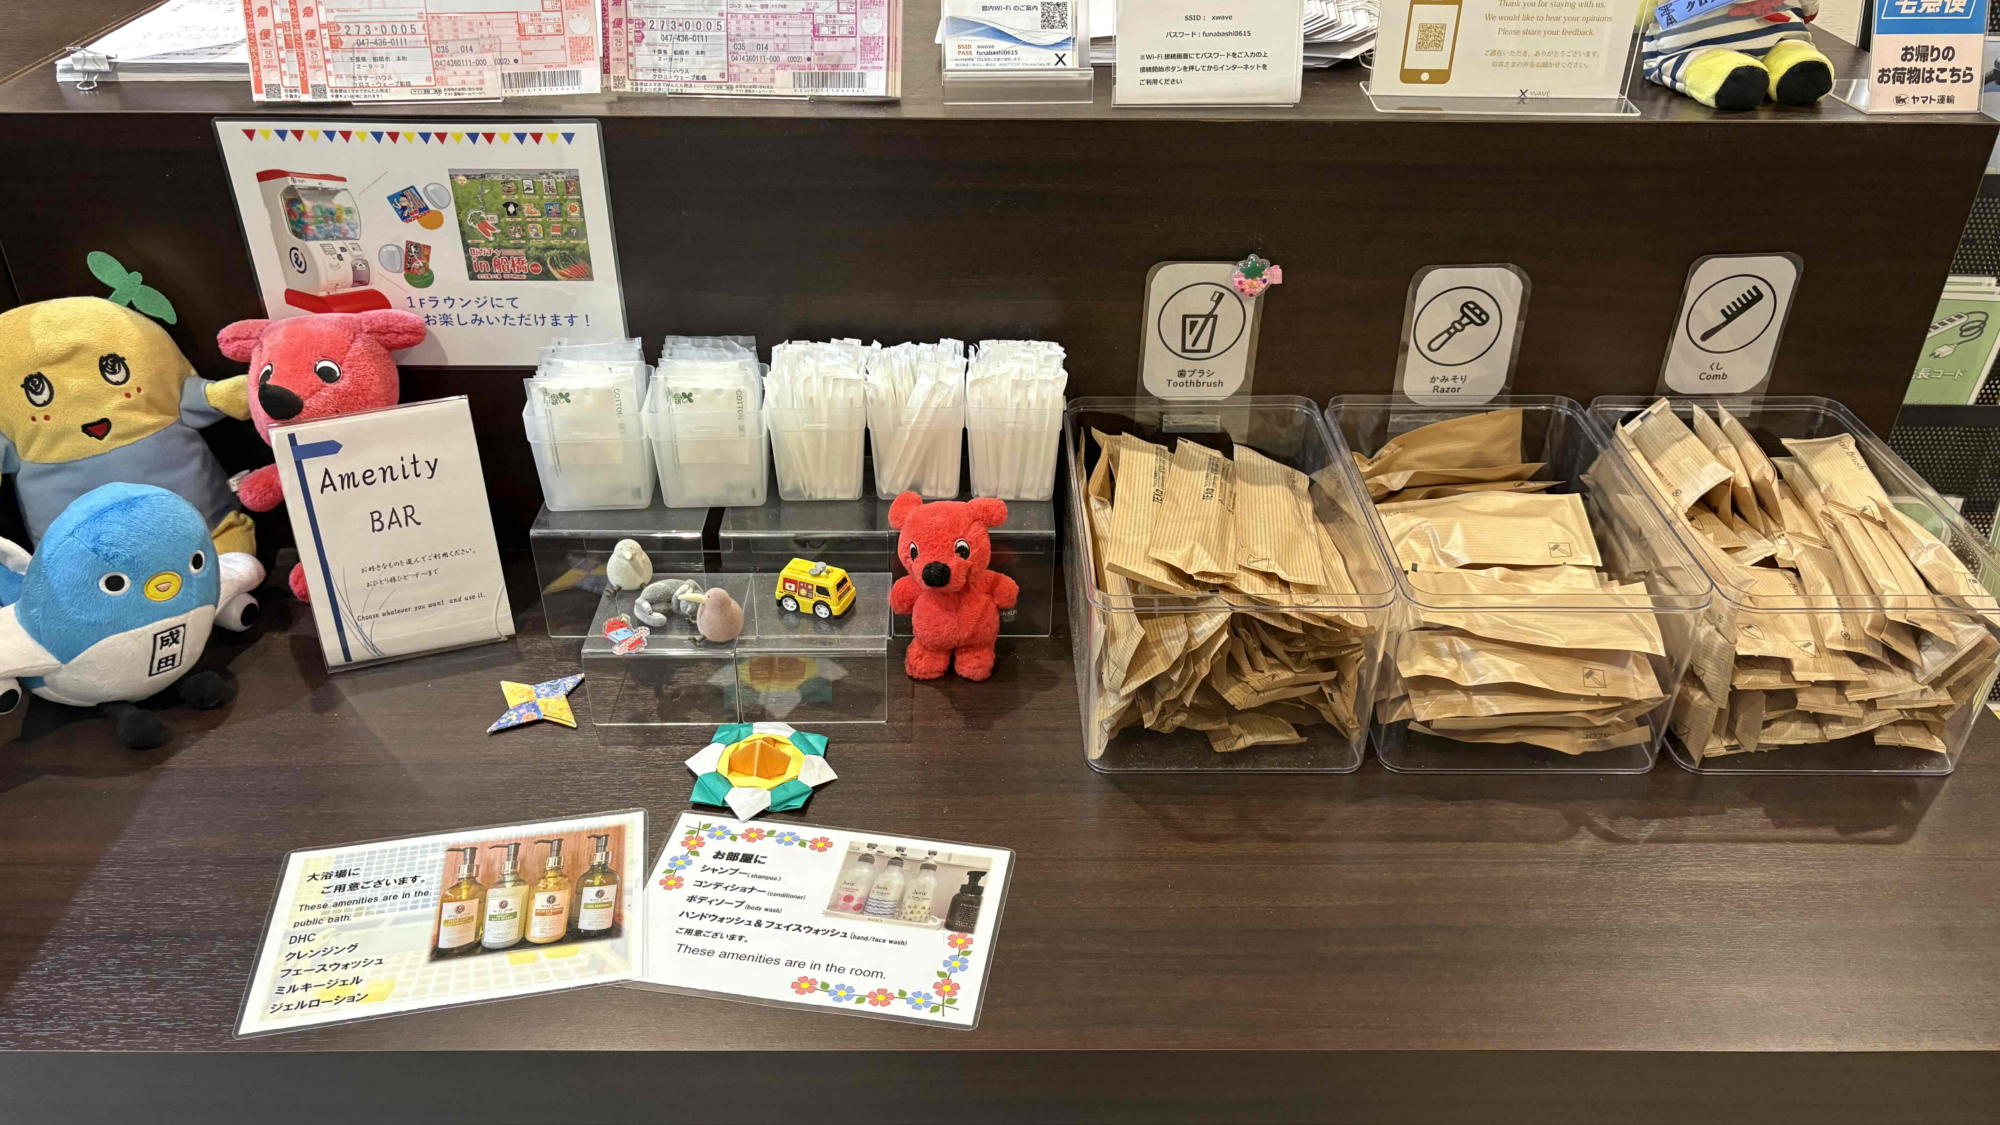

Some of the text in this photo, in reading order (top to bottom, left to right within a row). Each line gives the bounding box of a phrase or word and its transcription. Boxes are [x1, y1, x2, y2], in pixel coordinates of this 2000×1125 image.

[1537, 0, 1548, 8] for
[1550, 0, 1577, 9] staying
[1563, 15, 1580, 23] your
[661, 34, 708, 42] 047-436-0111
[1202, 30, 1251, 38] funabashi0615
[1543, 29, 1560, 37] your
[356, 38, 407, 46] 047-436-0111
[436, 45, 473, 53] 035 014
[1900, 45, 1956, 63] お帰りの
[1139, 64, 1268, 73] 接続開始ボタンを押してからインターネットを
[1139, 78, 1183, 86] ご利用ください
[1877, 67, 1974, 85] お荷物はこちら
[1911, 95, 1955, 105] ヤマト運輸
[473, 257, 490, 273] in
[492, 256, 528, 273] 船橋
[406, 295, 520, 309] 1Fラウンジにて
[424, 312, 591, 328] お楽しみいただけます！
[1177, 369, 1215, 378] 歯ブラシ
[1709, 362, 1723, 371] くし
[1166, 379, 1224, 388] Toothbrush
[1430, 375, 1467, 384] かみそり
[1698, 372, 1728, 381] Comb
[1432, 386, 1462, 394] Razor
[320, 453, 439, 494] Amenity
[369, 505, 422, 533] BAR
[357, 613, 379, 622] Choose
[382, 607, 411, 617] whatever
[414, 605, 426, 613] you
[428, 600, 444, 608] want
[449, 596, 462, 604] and
[157, 629, 180, 672] 成田
[712, 850, 768, 865] お部屋に
[306, 868, 361, 883] 大浴場に
[320, 875, 426, 895] ご用意ございます。
[692, 879, 767, 894] コンディショナー
[298, 889, 430, 912] These amenities are in the
[293, 915, 351, 928] public bath.
[288, 932, 317, 945] DHC
[675, 927, 749, 944] ご用意ございます。
[284, 943, 359, 961] クレンジング
[280, 957, 384, 979] フェースウォッシュ
[676, 943, 887, 980] These amenities are in the room.
[274, 975, 363, 995] ミルキージェル
[269, 993, 369, 1014] ジェルローション
